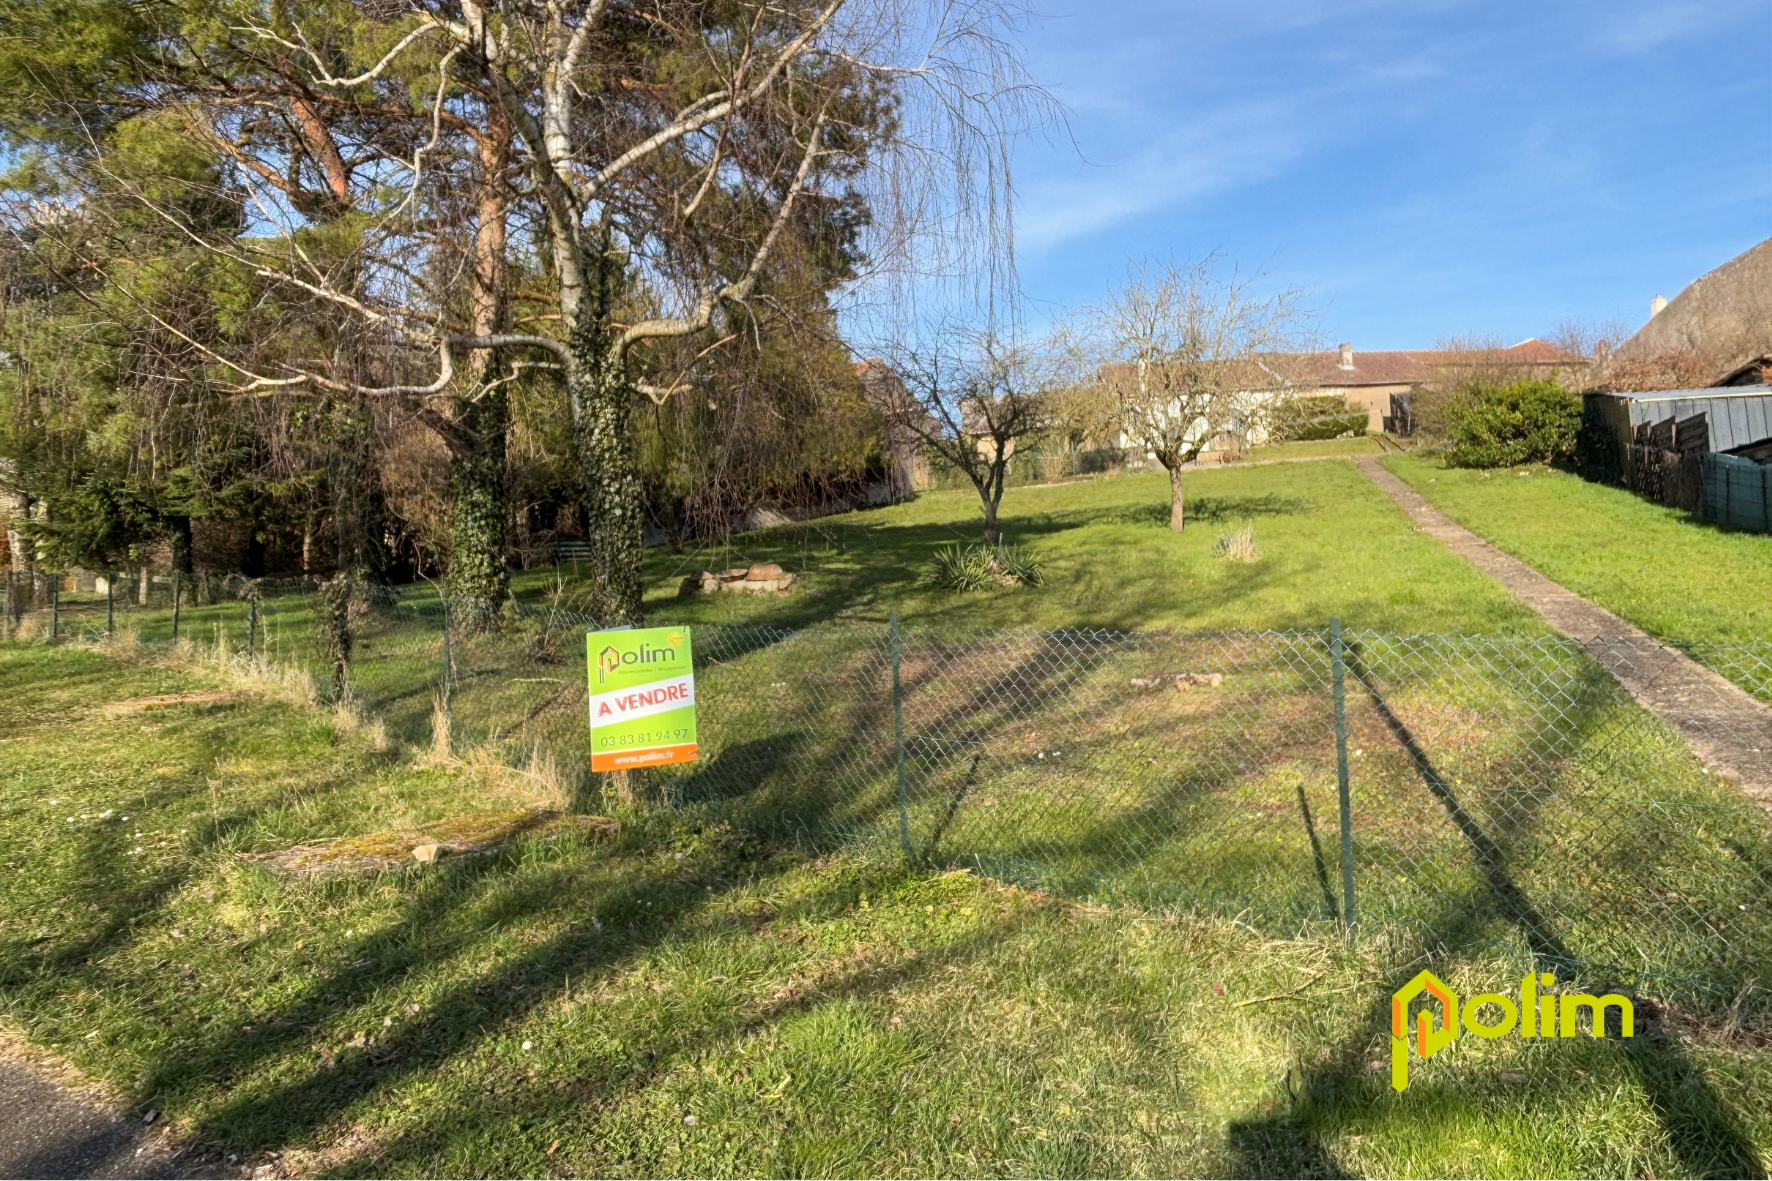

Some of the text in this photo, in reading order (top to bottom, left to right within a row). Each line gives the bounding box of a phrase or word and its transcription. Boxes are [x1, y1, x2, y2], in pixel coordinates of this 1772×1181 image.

[598, 683, 689, 717] A VENDRE
[601, 728, 688, 747] 03 83 81 94 97
[615, 750, 674, 764] www.polim.fr
